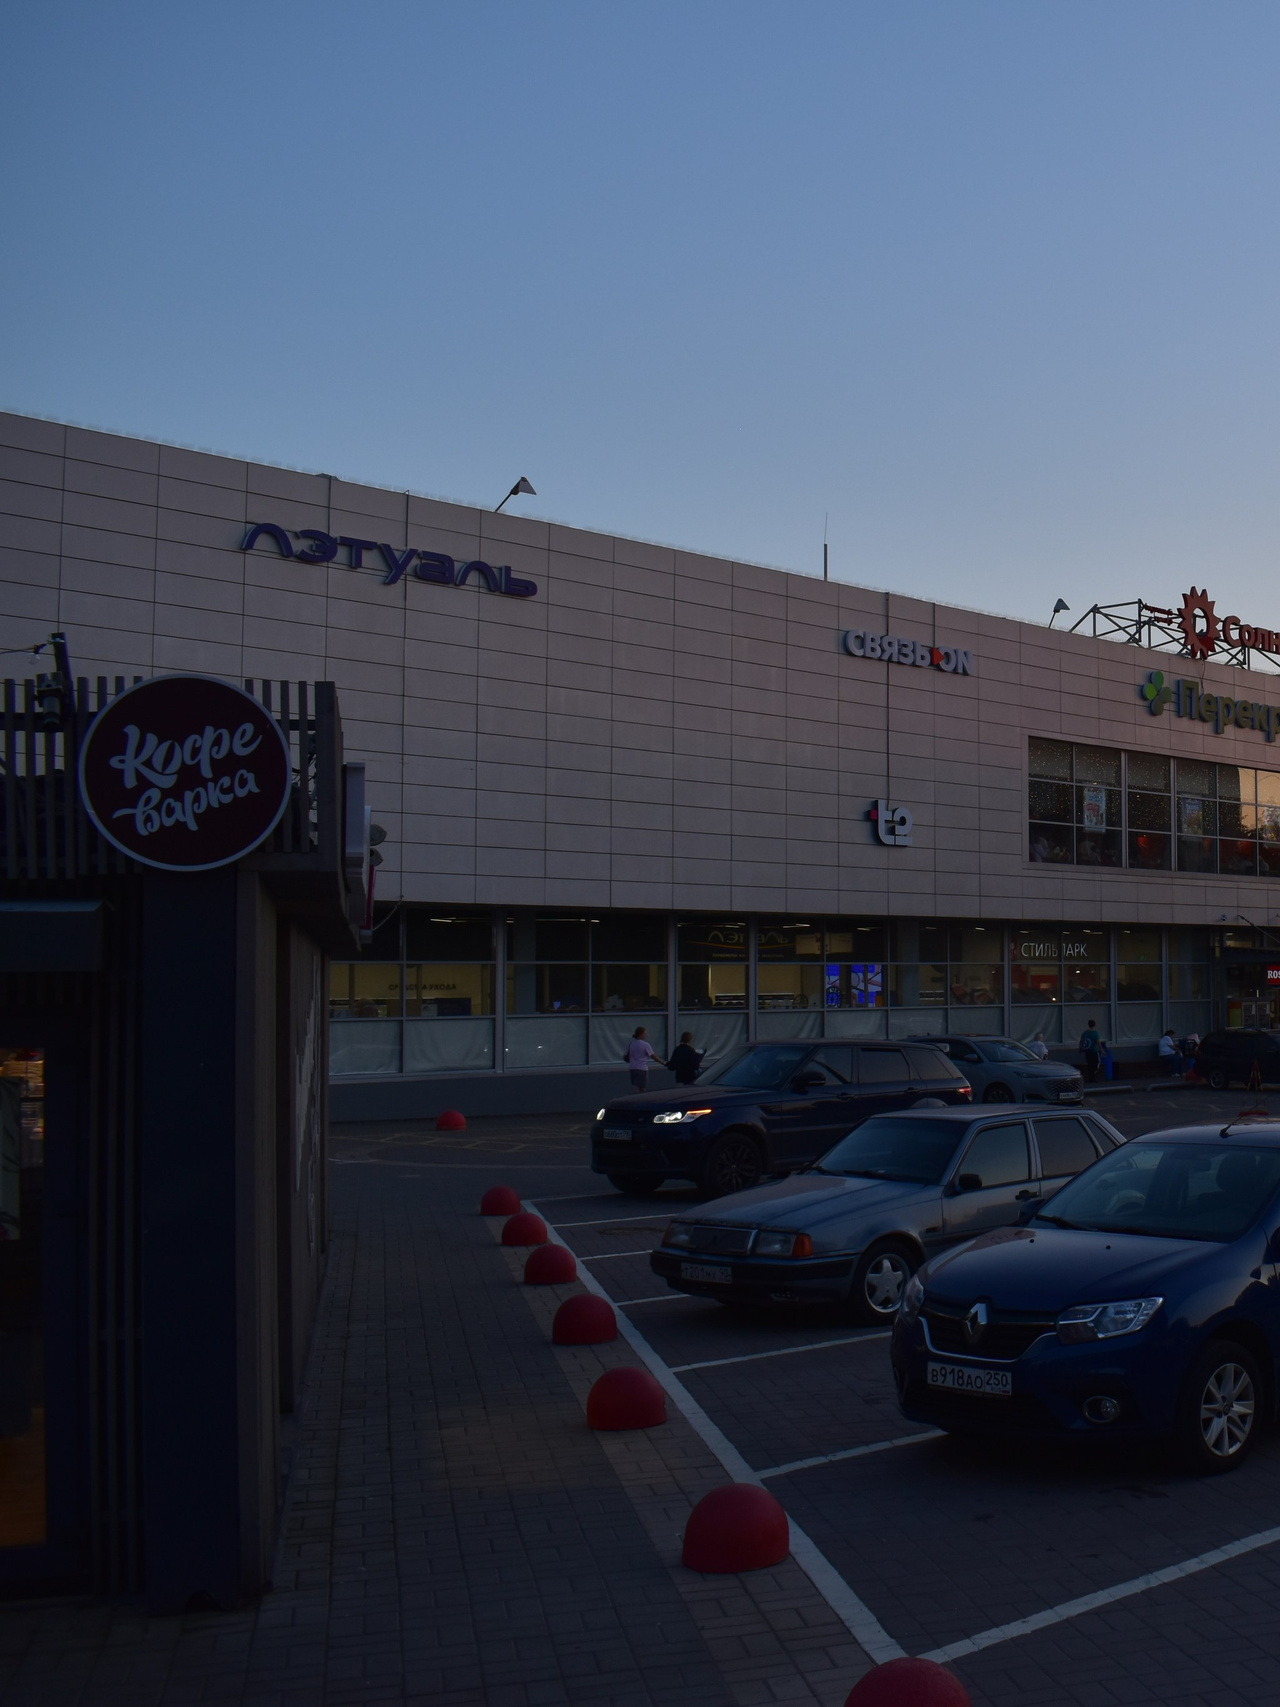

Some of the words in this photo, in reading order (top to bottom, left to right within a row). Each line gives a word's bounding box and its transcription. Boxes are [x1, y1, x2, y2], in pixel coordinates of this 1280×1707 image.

[845, 629, 931, 667] СВЯЗЬ
[109, 722, 262, 789] Кофе
[112, 765, 261, 836] варка
[1021, 943, 1058, 957] СТИЛЬ
[429, 983, 457, 991] УХОДА
